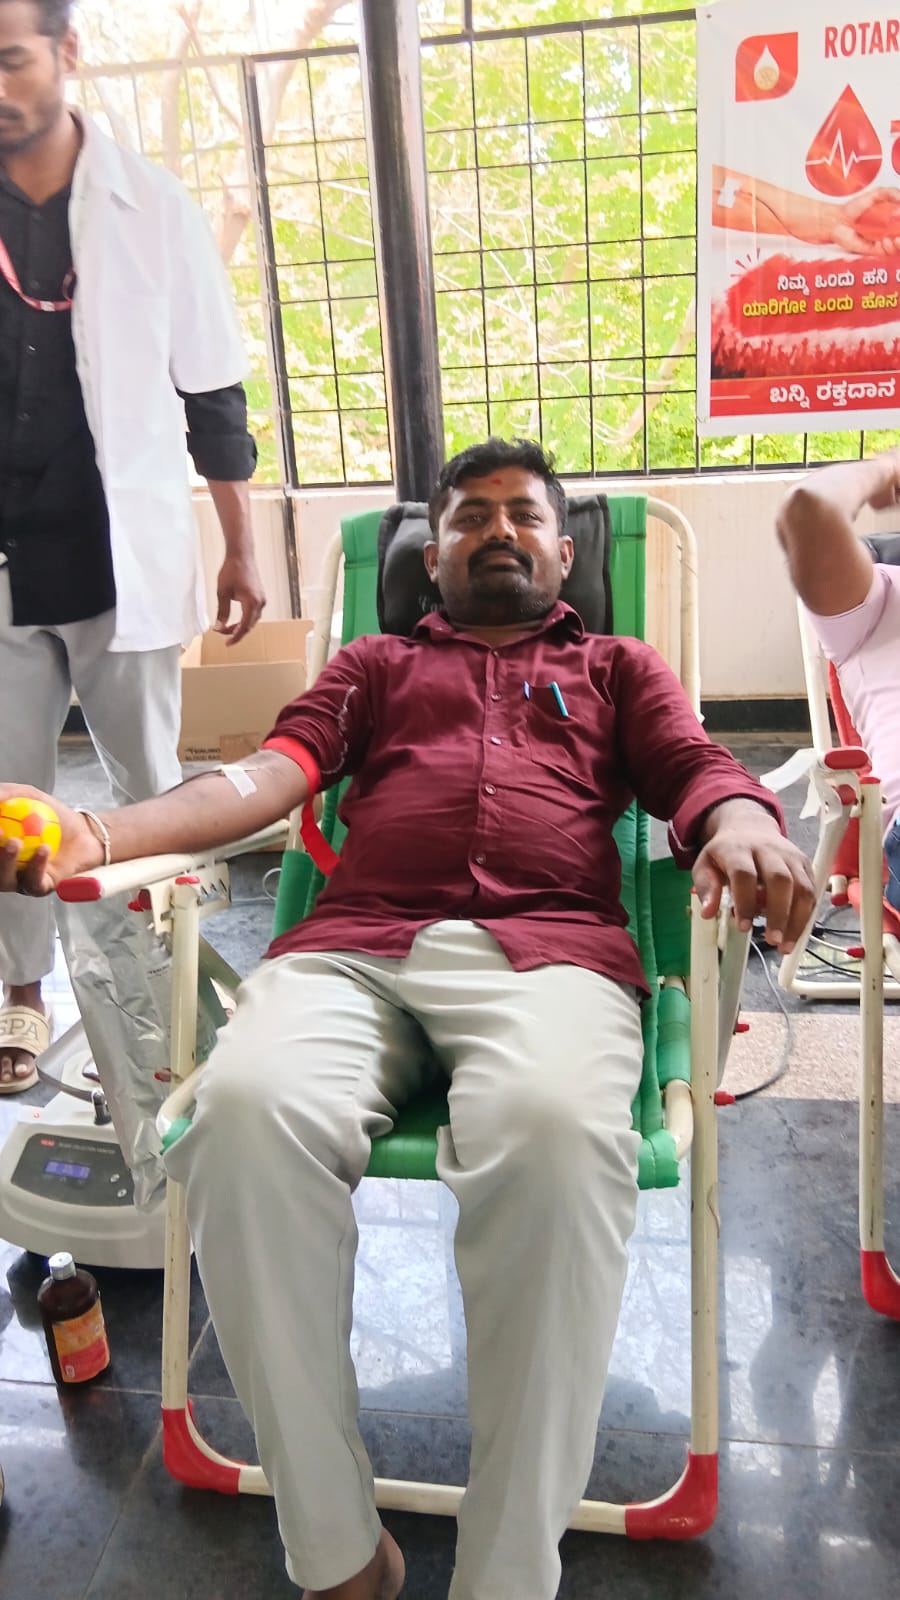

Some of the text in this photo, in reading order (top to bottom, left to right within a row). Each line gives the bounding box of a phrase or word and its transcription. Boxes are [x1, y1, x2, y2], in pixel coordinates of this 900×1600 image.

[824, 19, 900, 59] ROTAR
[777, 273, 810, 296] ನಿಮ್ಮ
[815, 269, 855, 288] ಒಂದು
[862, 267, 888, 285] ಹನಿ
[814, 294, 853, 312] ಒಂದು
[769, 377, 896, 409] ಬನ್ನಿ ರಕ್ತದಾನ
